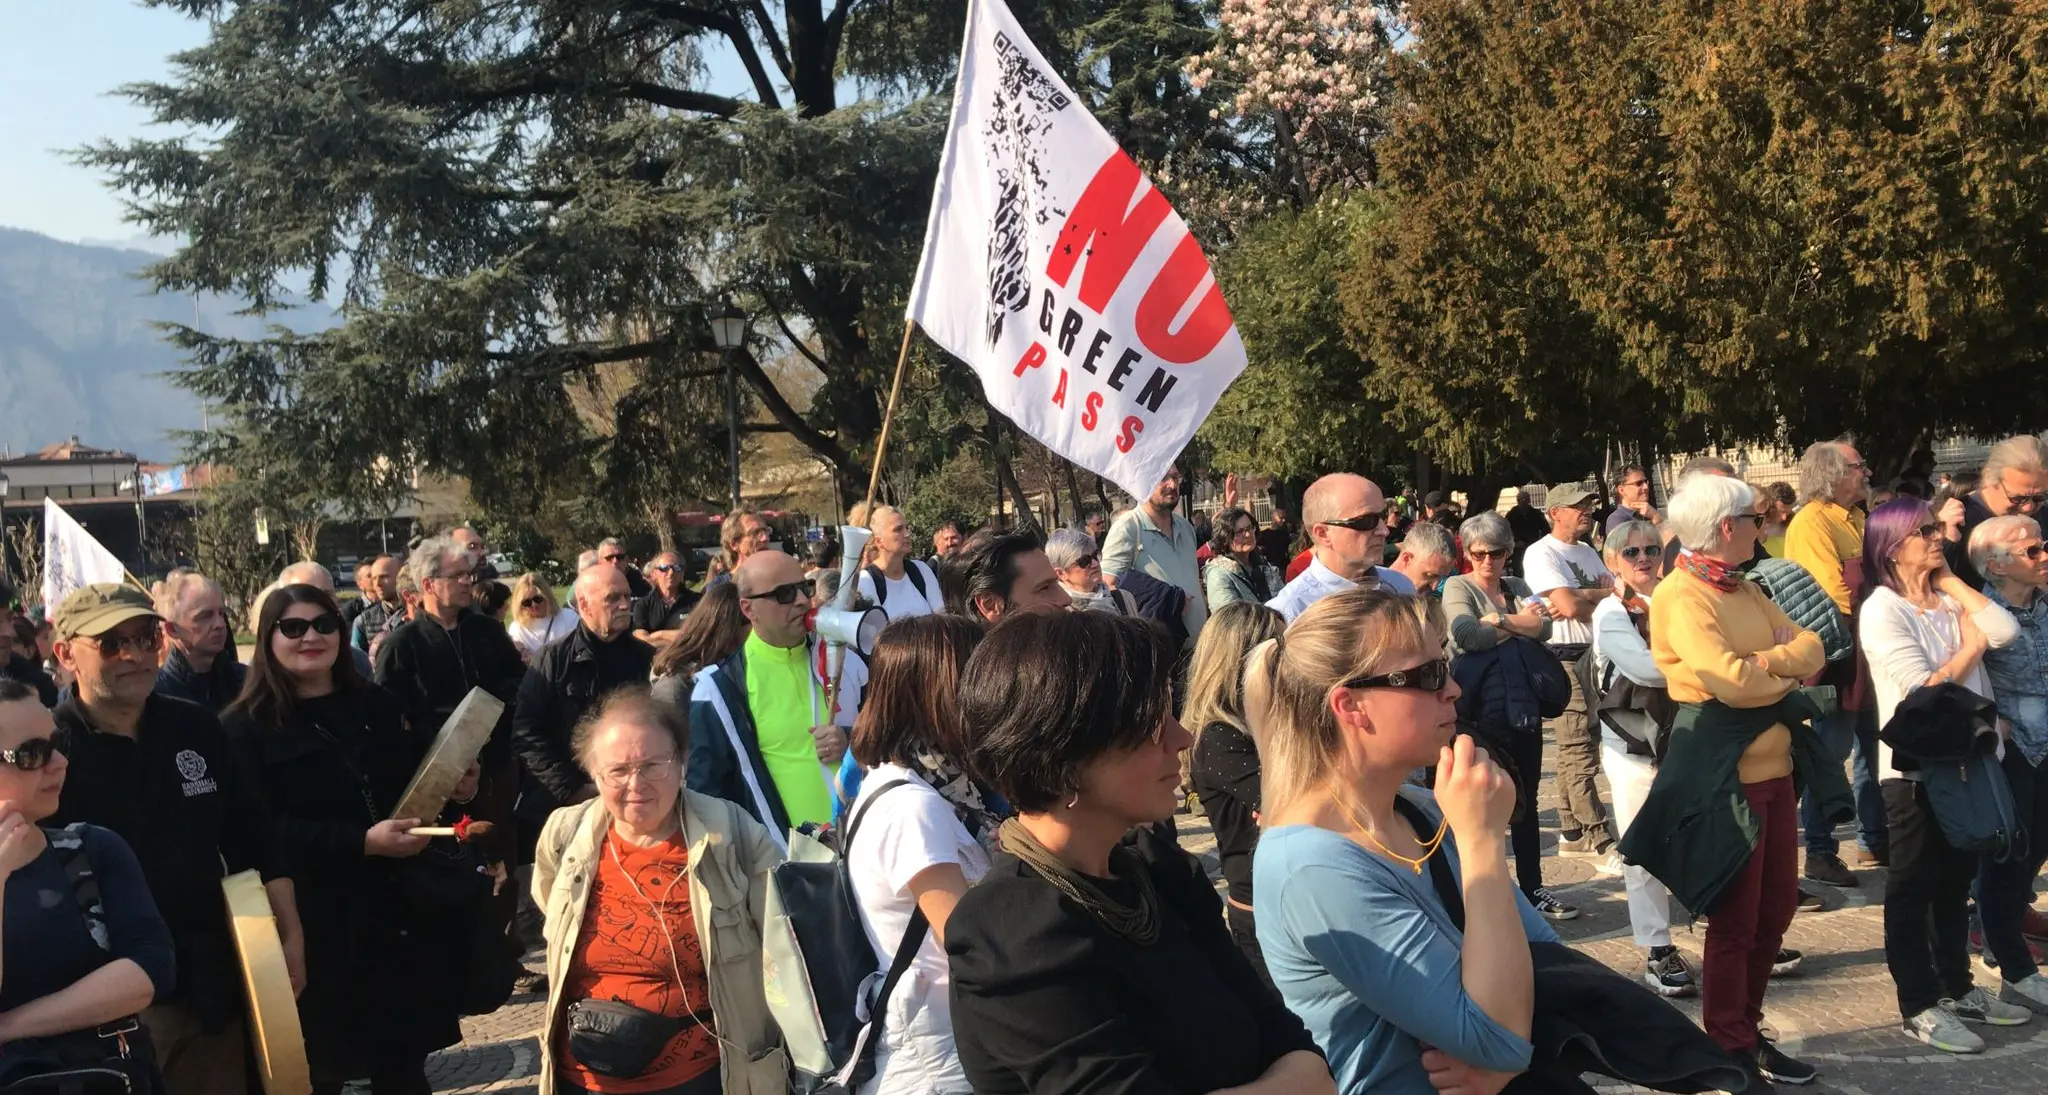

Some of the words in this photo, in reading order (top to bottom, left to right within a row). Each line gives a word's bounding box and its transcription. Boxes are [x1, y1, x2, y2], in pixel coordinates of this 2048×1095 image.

[1046, 147, 1234, 364] NO
[1012, 341, 1145, 454] PASS
[1039, 288, 1179, 414] GREEN
